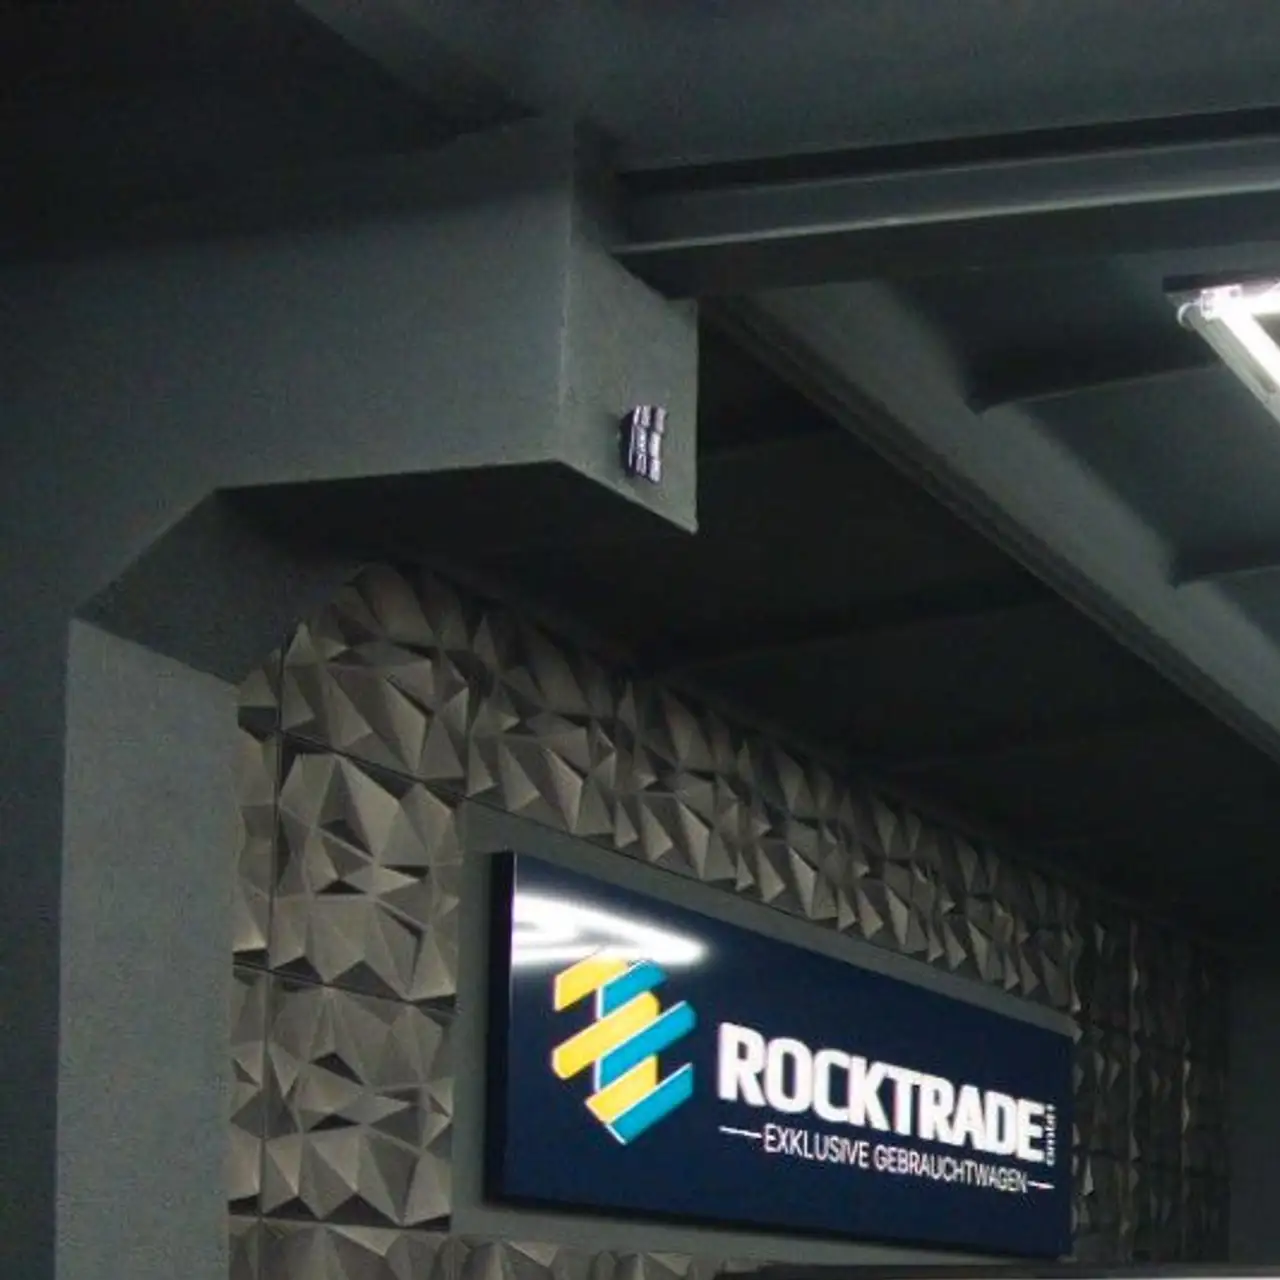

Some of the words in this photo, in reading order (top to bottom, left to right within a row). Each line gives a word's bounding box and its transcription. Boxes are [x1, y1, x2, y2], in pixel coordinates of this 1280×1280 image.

[717, 1022, 1045, 1163] ROCKTRADE
[762, 1123, 871, 1169] EXKLUSIVE
[873, 1144, 1028, 1194] GEBRAUCHTWAGEN
